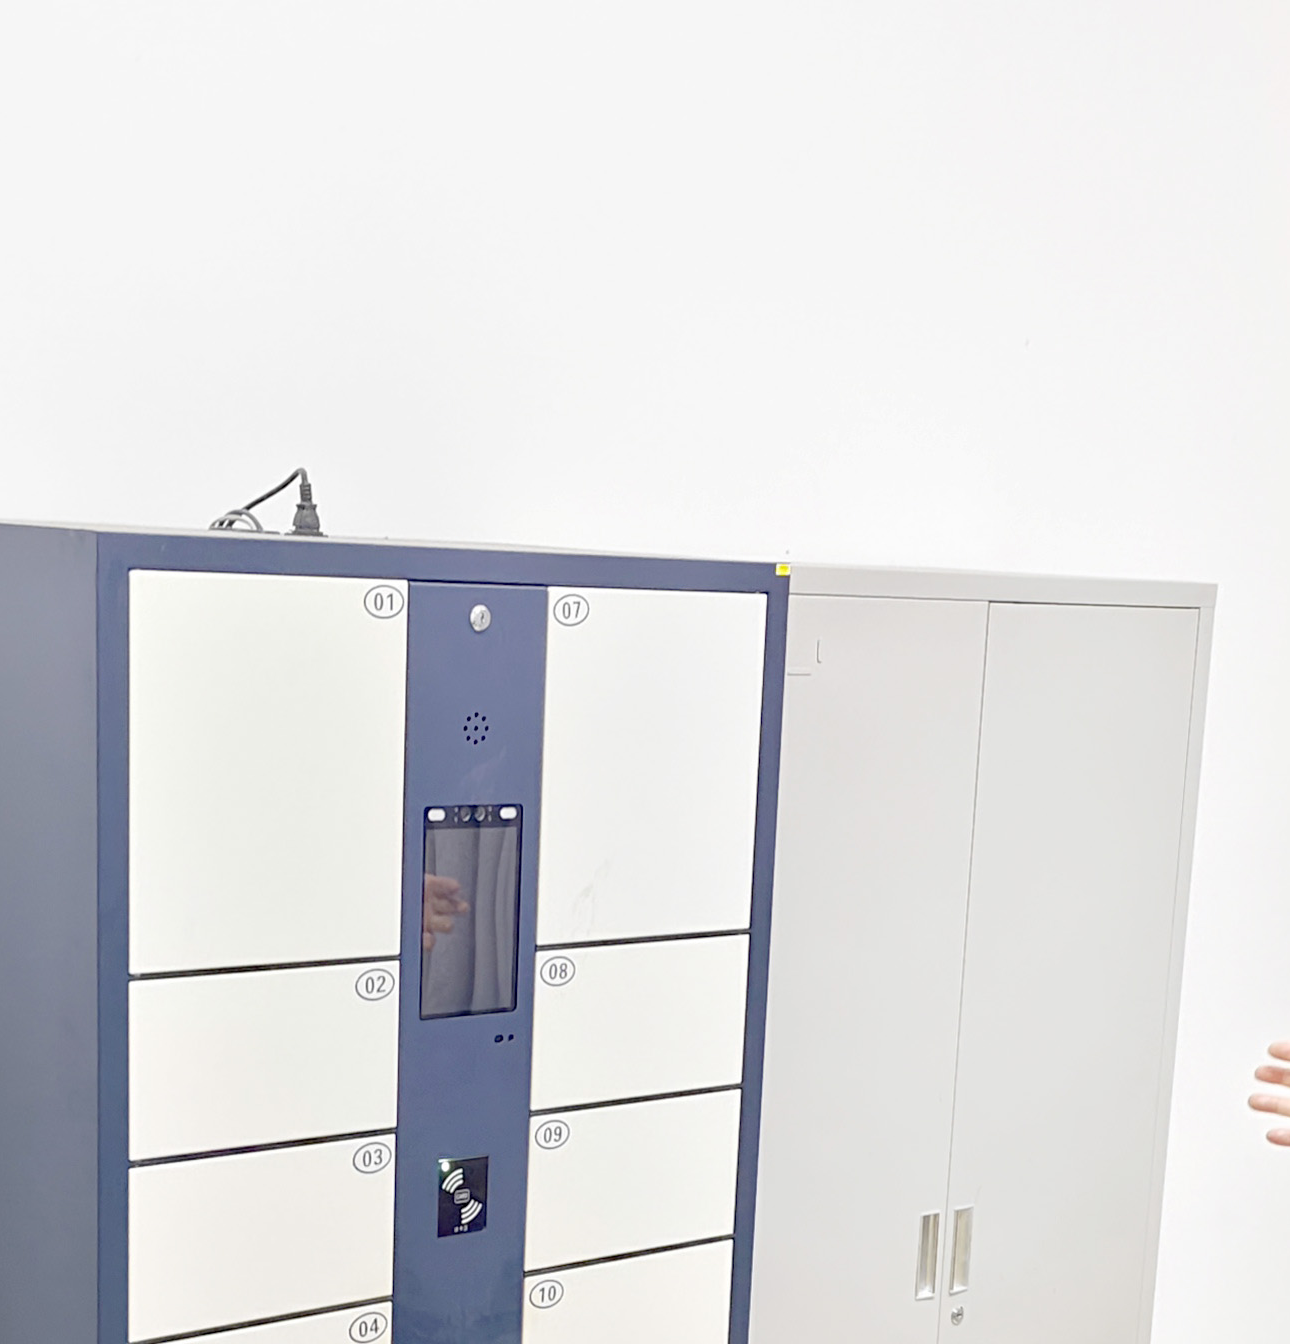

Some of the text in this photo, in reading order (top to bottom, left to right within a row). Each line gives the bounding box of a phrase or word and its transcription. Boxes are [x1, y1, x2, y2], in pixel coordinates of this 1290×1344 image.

[373, 592, 395, 612] 01
[561, 601, 582, 619] 07
[548, 962, 568, 980] 08
[365, 974, 386, 994] 02
[543, 1125, 563, 1144] 09
[361, 1149, 383, 1168] 03
[538, 1285, 557, 1303] 10
[358, 1318, 380, 1337] 04
